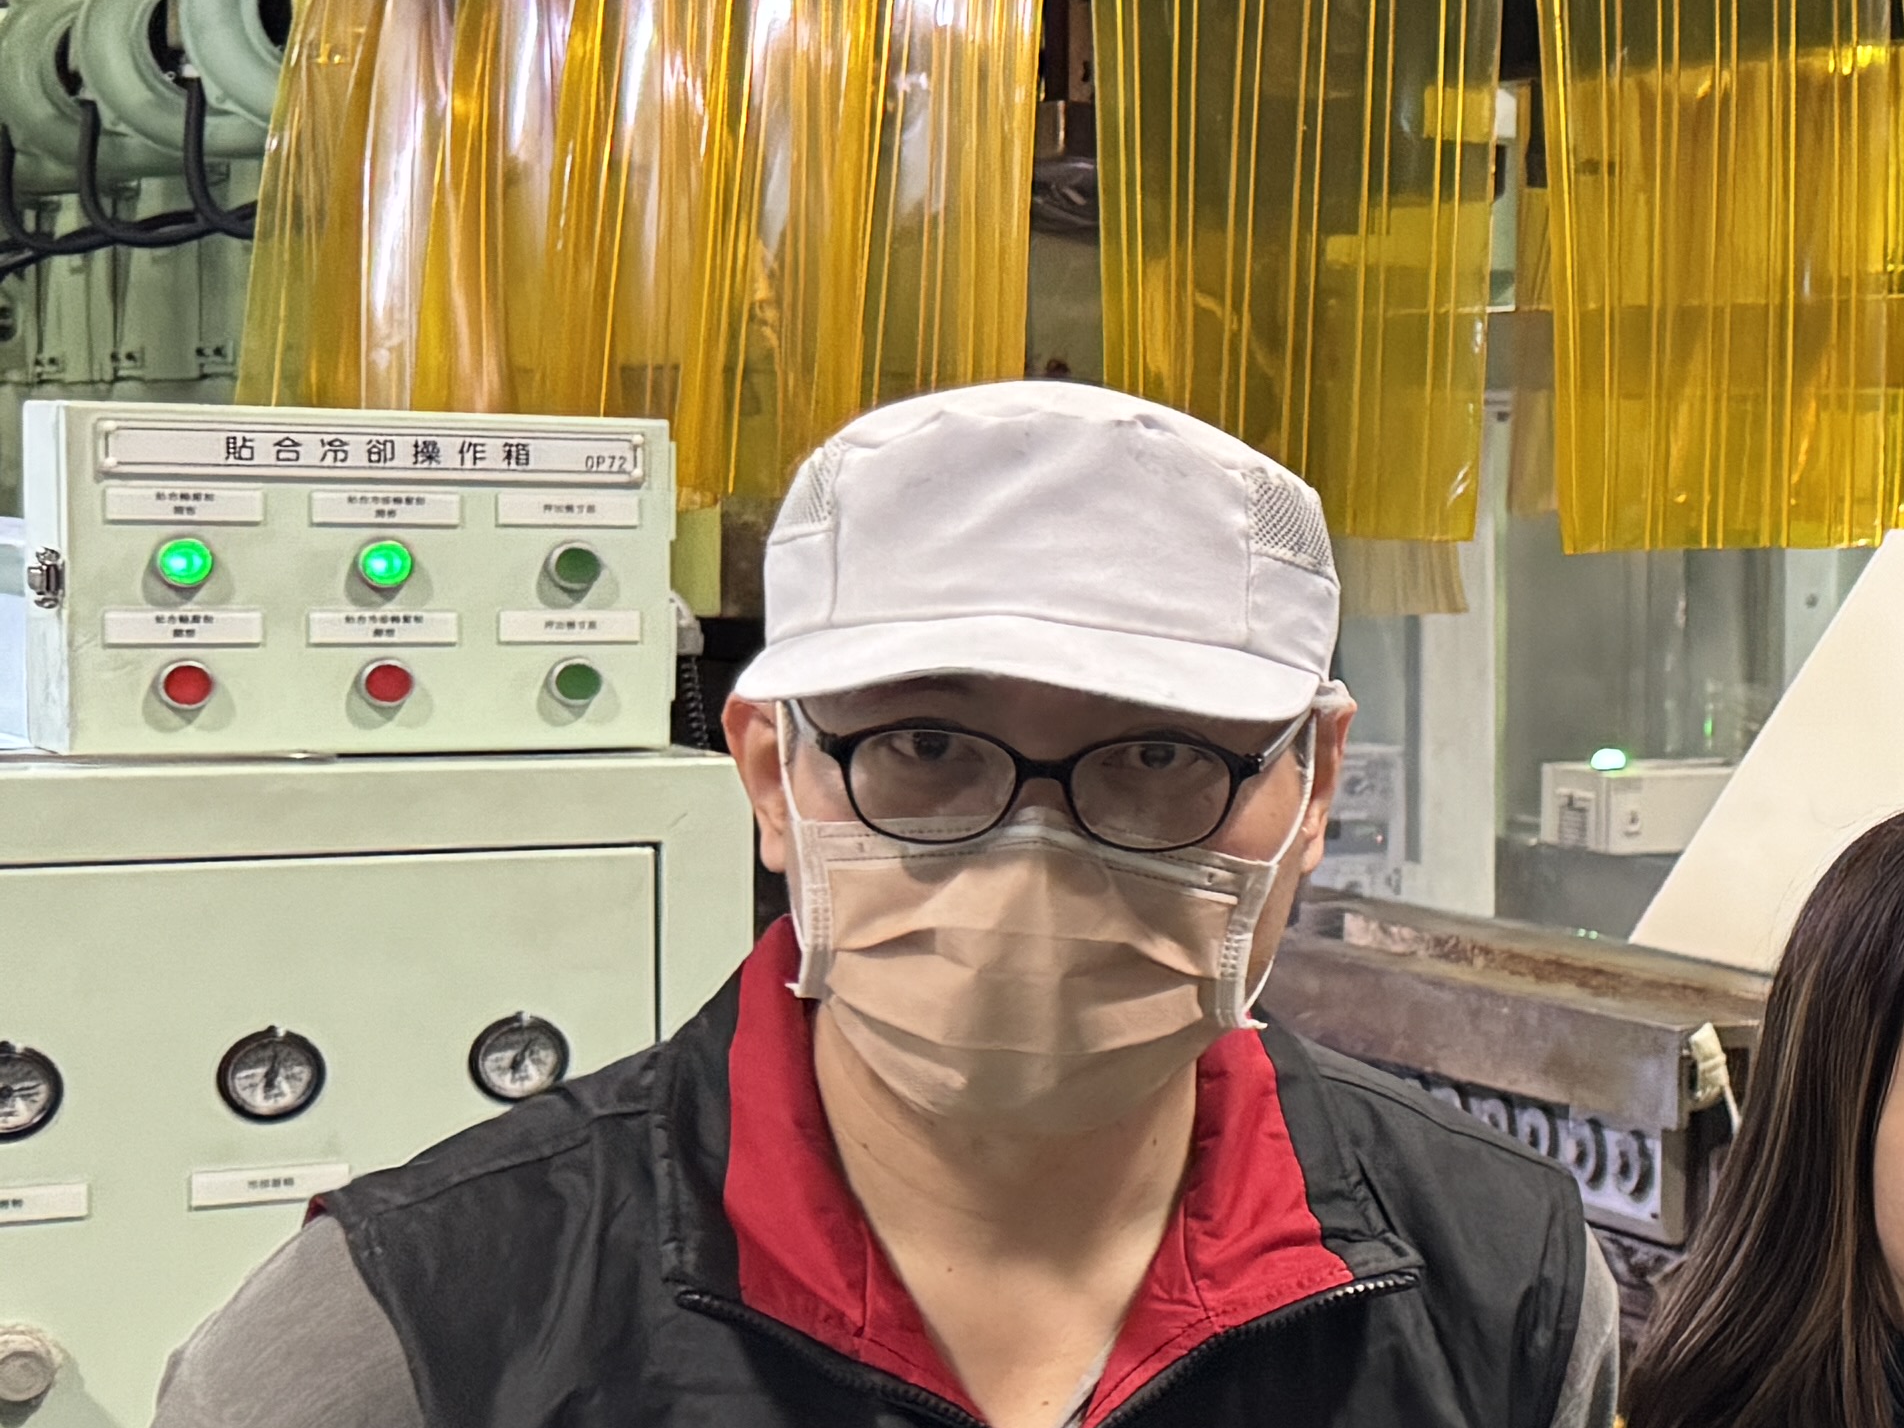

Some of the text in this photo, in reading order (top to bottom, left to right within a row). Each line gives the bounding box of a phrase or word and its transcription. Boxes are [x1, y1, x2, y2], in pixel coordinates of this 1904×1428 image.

[225, 436, 531, 467] 貼合冷卻操作箱
